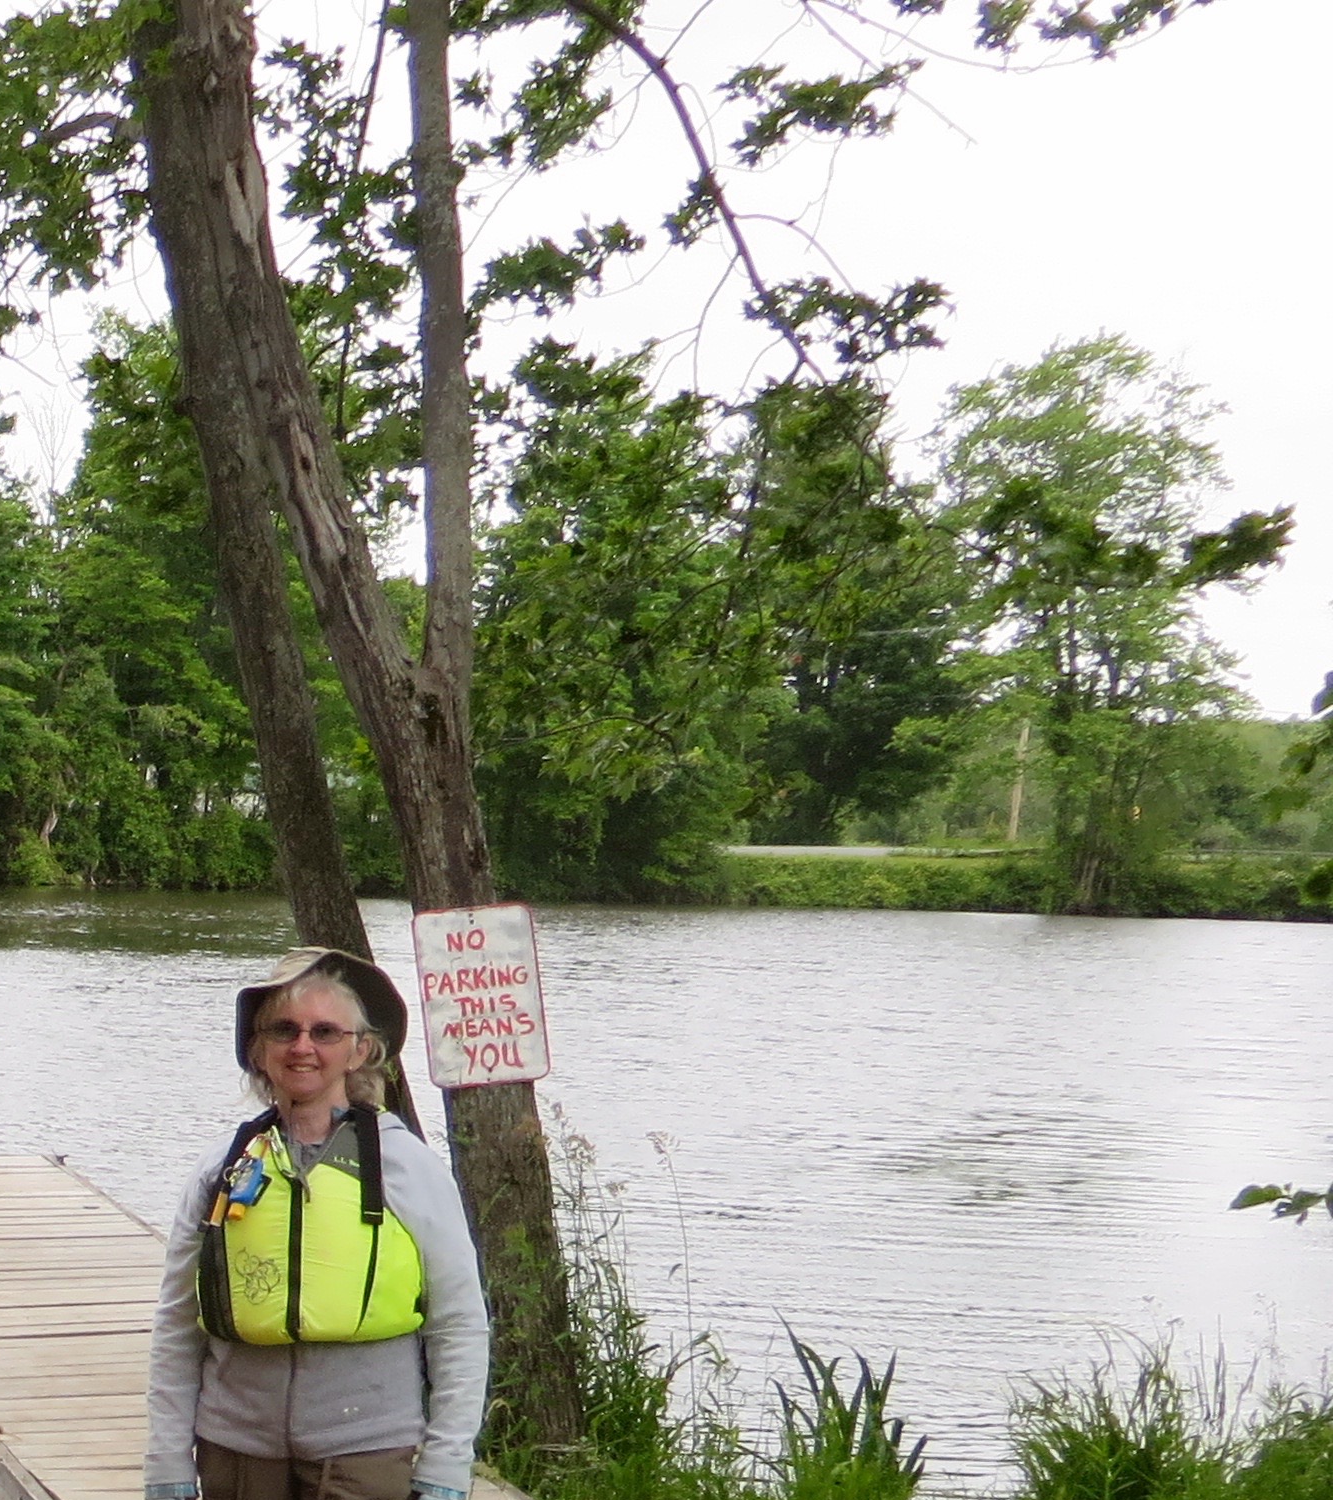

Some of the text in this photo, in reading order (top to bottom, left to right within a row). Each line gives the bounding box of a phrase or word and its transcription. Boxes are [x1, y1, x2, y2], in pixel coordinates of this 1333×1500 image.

[446, 928, 486, 952] NO
[453, 993, 517, 1018] THIS
[442, 1012, 535, 1040] MEANS
[463, 1041, 524, 1075] YOU
